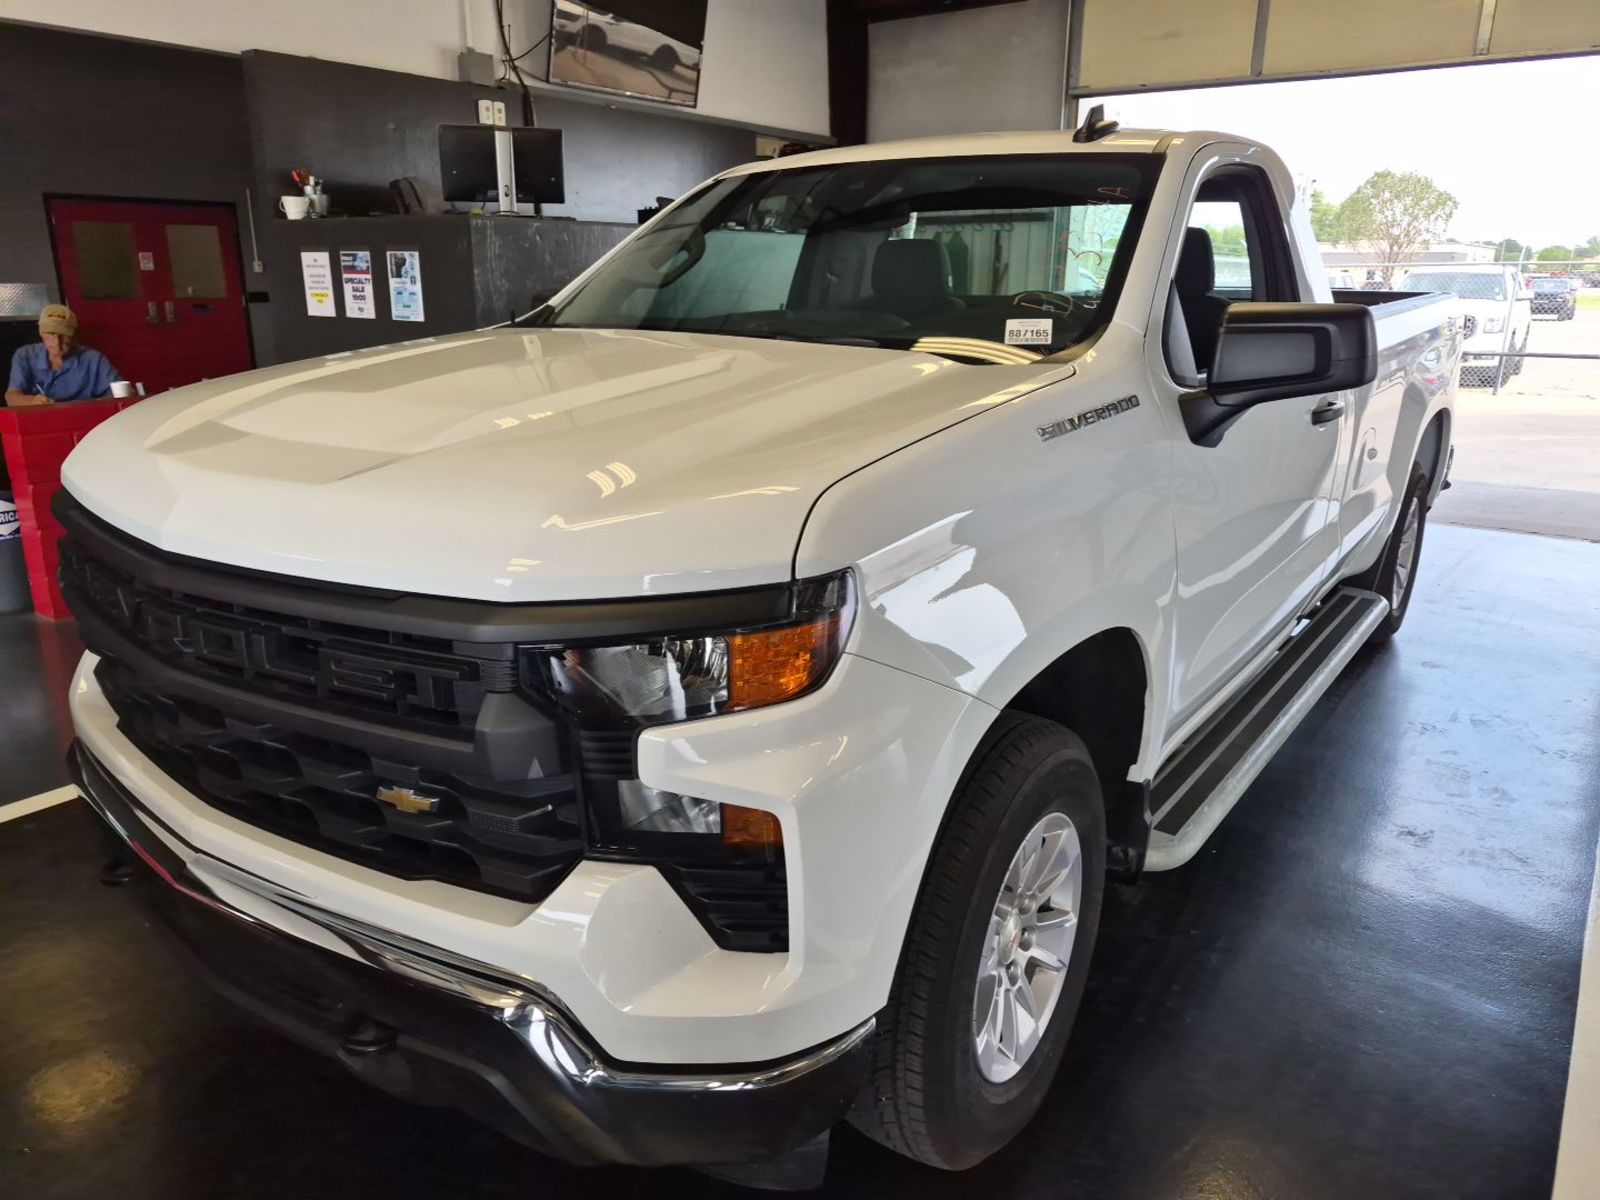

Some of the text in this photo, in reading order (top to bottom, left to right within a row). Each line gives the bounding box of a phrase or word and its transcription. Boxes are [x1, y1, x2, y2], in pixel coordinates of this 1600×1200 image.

[344, 277, 371, 285] SPECIALTY
[1008, 329, 1049, 338] 887165
[1036, 394, 1141, 442] SILVERADO
